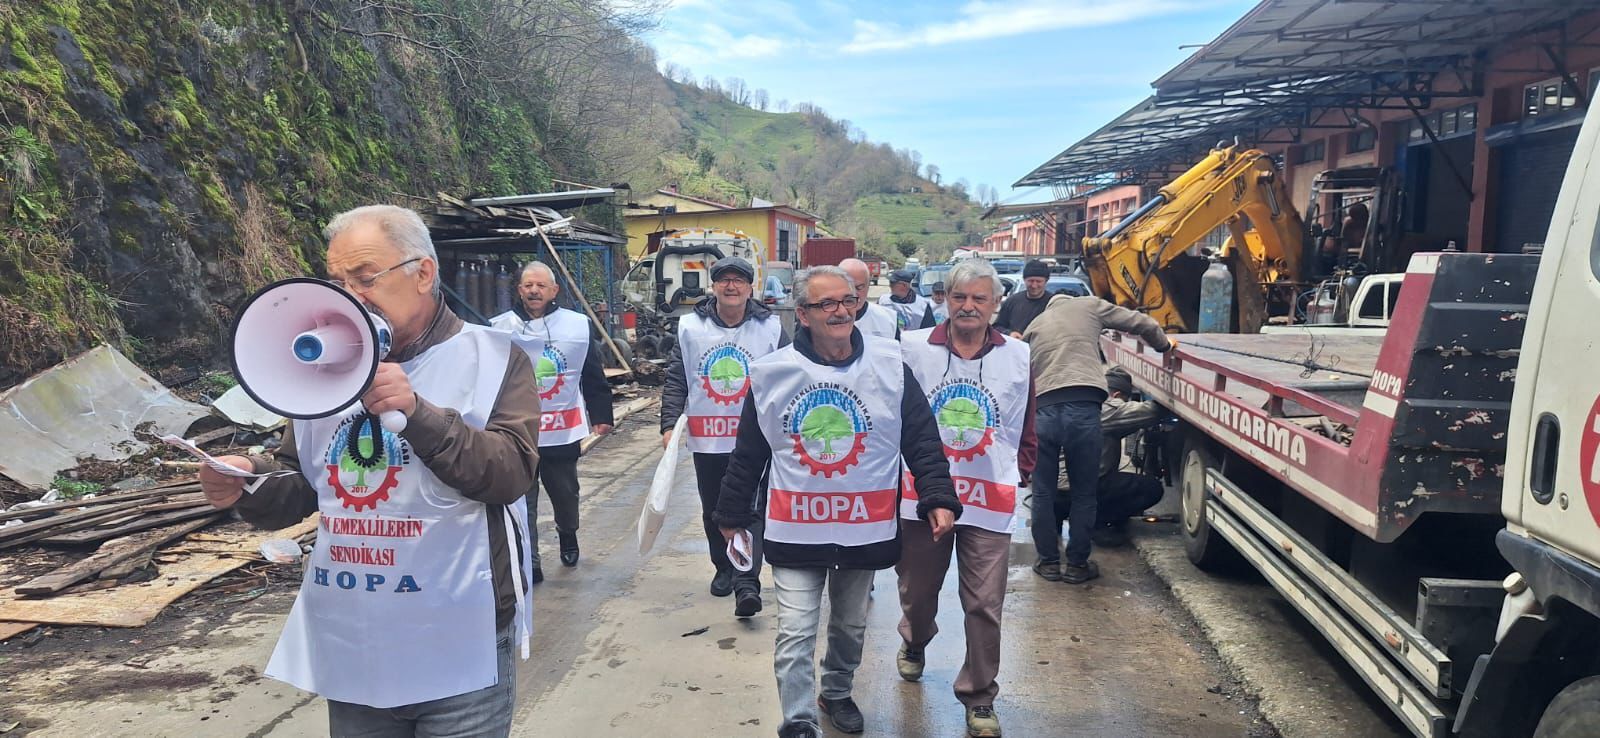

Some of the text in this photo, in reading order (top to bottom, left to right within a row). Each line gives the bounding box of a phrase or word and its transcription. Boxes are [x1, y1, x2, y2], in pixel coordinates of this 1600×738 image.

[1371, 369, 1402, 397] HOPA
[788, 382, 840, 412] EMEKLİLERİN
[540, 413, 566, 430] PA
[702, 418, 740, 436] HOP
[1172, 376, 1307, 467] OTO KURTARMA
[790, 494, 870, 520] HOPA
[332, 514, 422, 538] EMEKLİLERİN
[330, 542, 395, 566] SENDİKASI
[314, 566, 422, 593] HOPA
